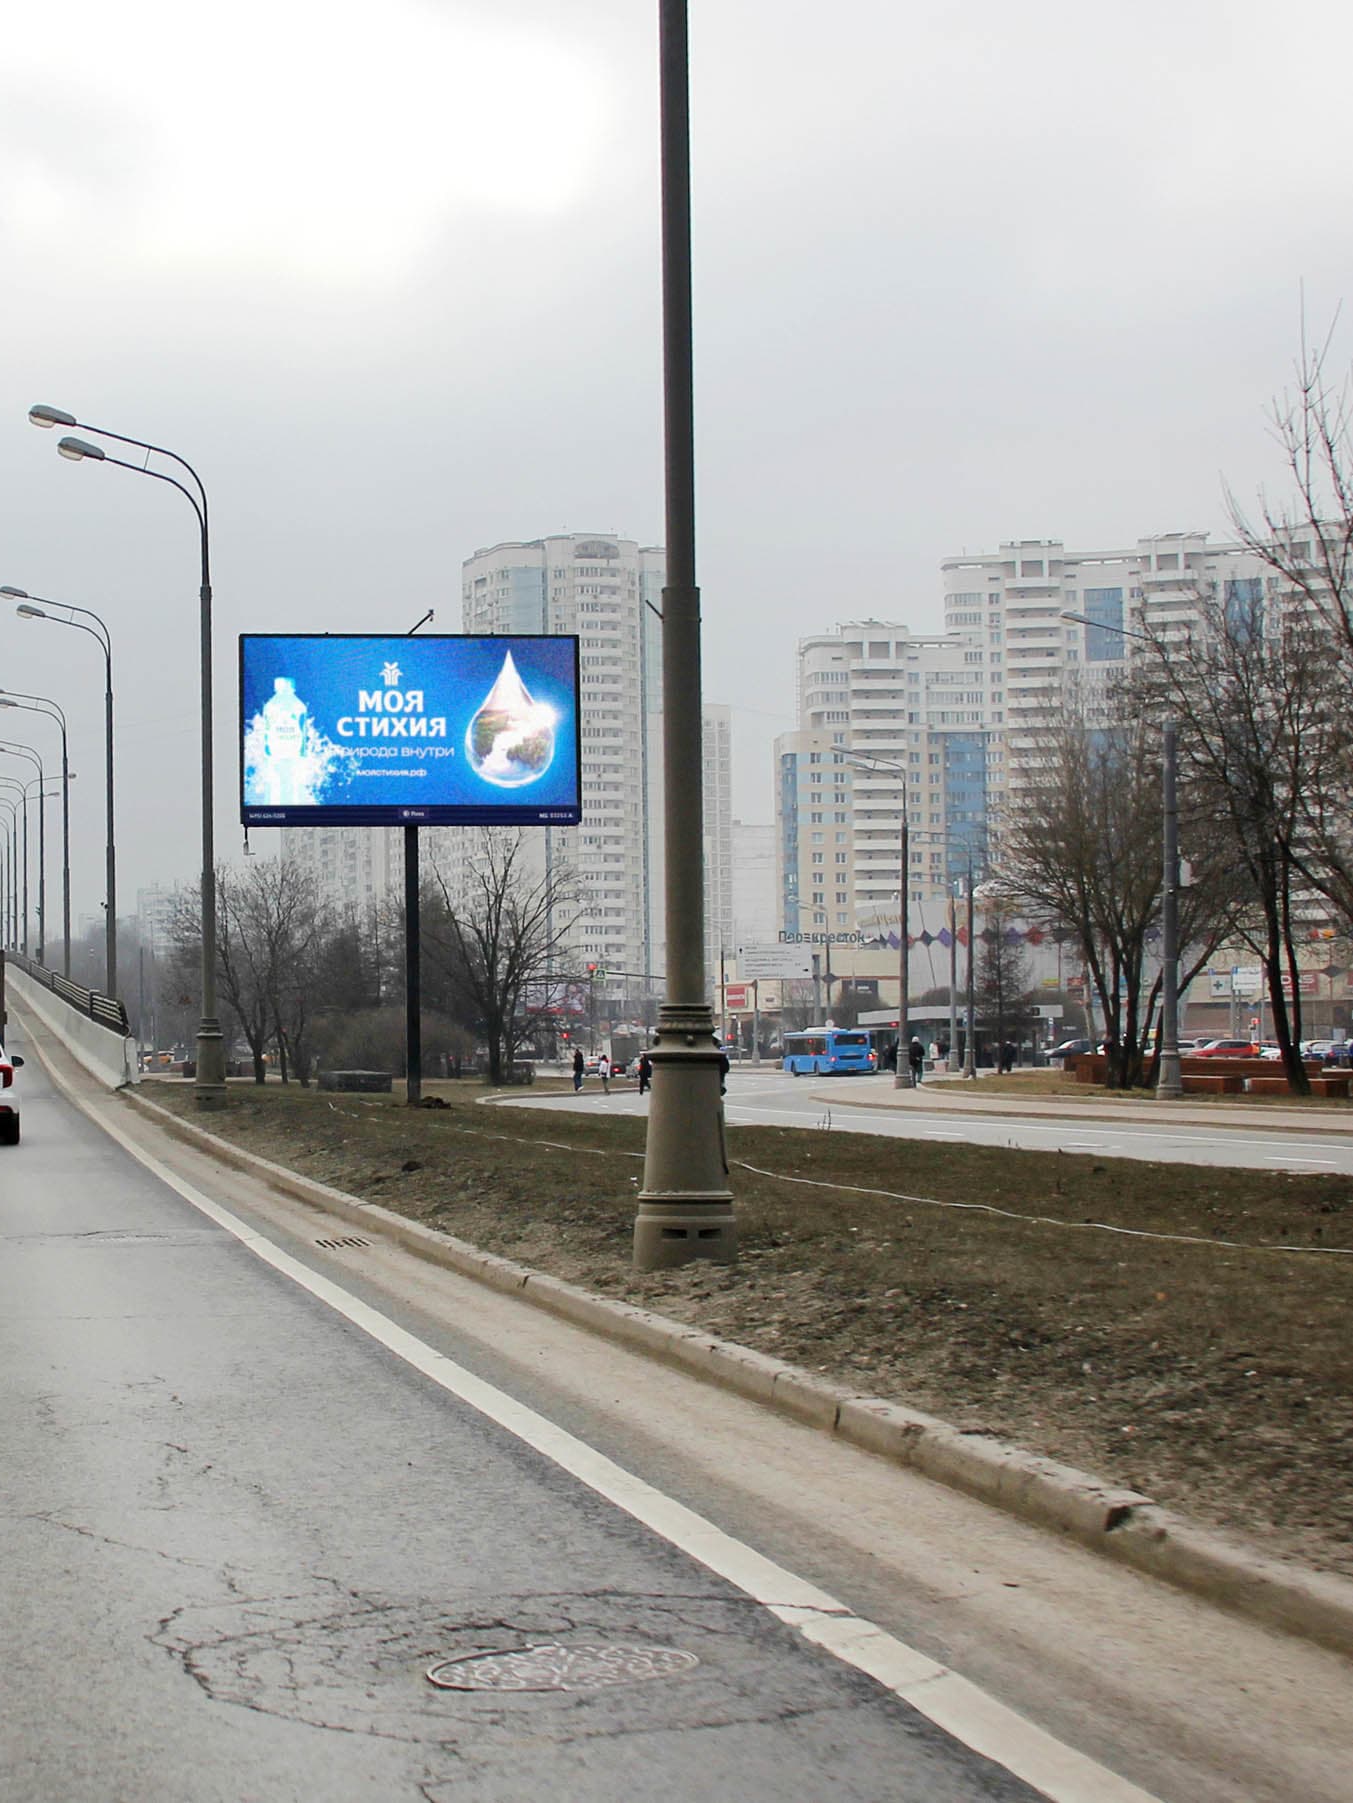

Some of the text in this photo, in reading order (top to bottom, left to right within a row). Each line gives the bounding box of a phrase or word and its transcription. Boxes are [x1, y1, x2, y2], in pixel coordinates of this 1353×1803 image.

[358, 690, 424, 713] МОЯ
[336, 716, 447, 737] СТИХИЯ
[332, 747, 455, 760] рирода внутри
